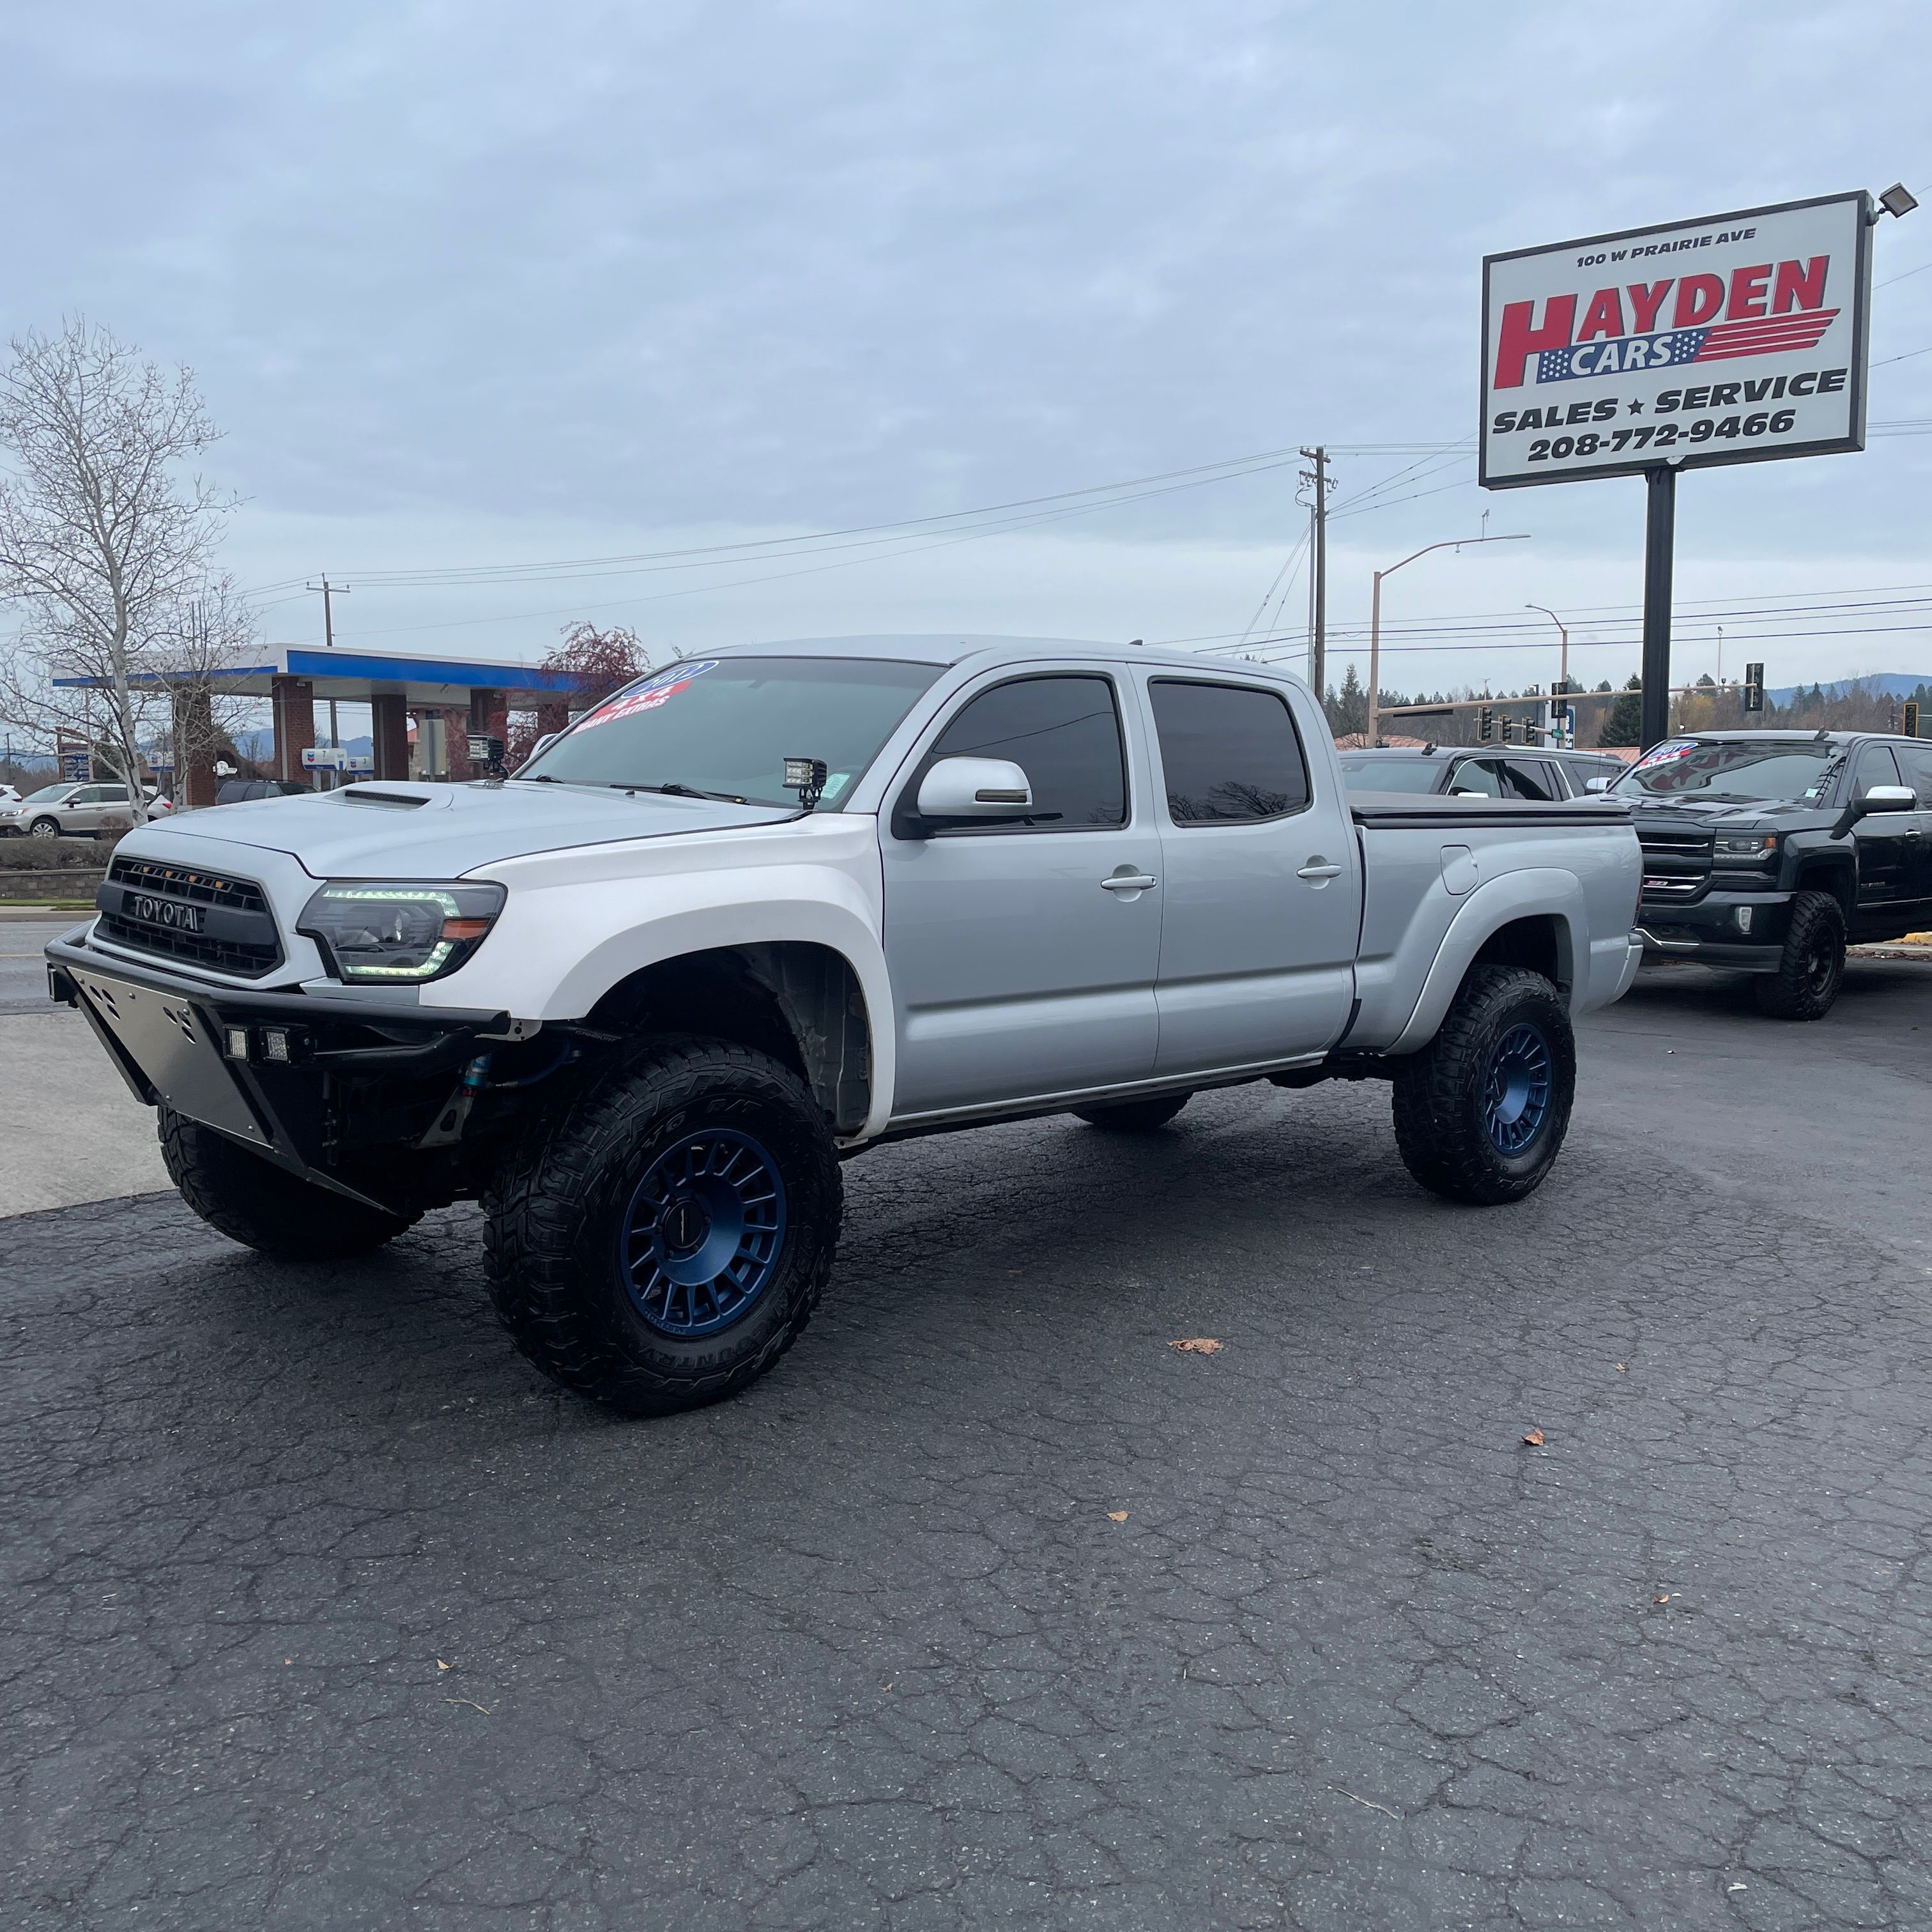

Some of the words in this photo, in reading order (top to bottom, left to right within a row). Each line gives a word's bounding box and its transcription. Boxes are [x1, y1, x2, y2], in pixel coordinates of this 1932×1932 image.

[1577, 254, 1606, 268] 100
[1611, 250, 1628, 262] W
[1630, 235, 1713, 259] PRAIRIE
[1715, 227, 1756, 245] AVE
[1494, 254, 1831, 390] HAYDEN
[1570, 335, 1674, 376] CARS
[1492, 398, 1619, 434] SALES
[1654, 368, 1848, 414] SERVICE
[1528, 409, 1796, 462] 208-772-9466
[617, 695, 670, 719] EXTRAS
[134, 896, 199, 931] TOYOTA
